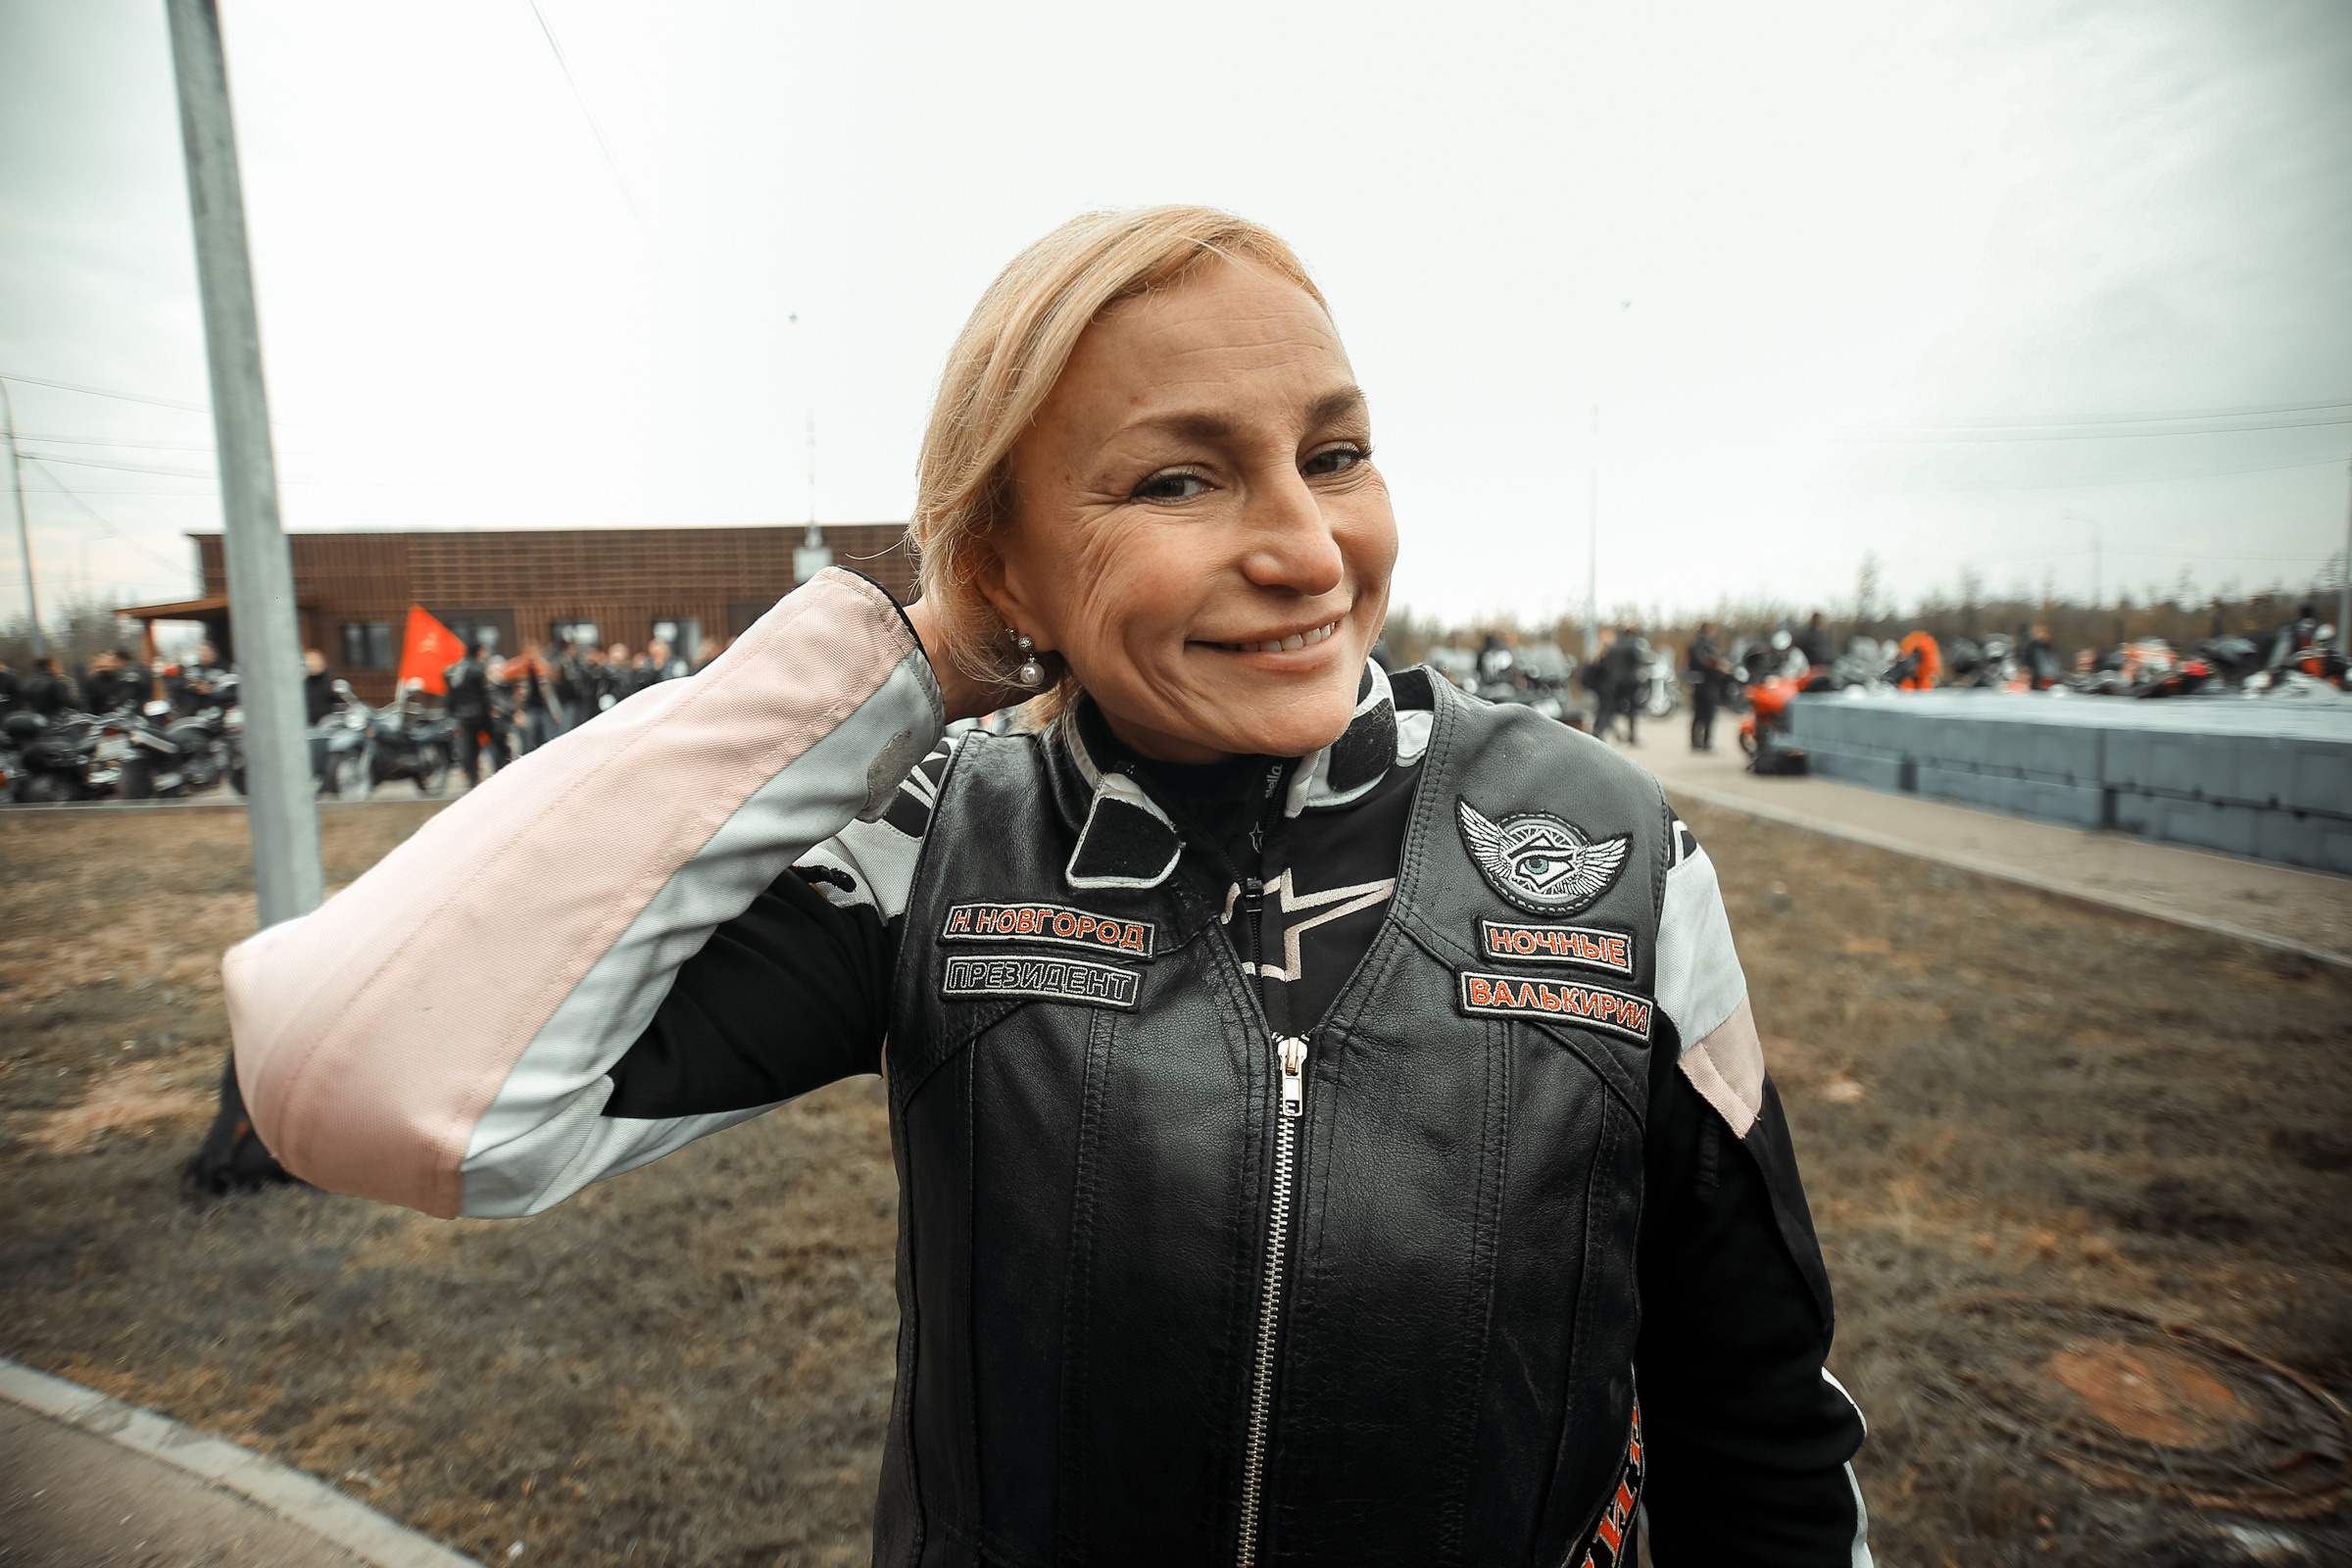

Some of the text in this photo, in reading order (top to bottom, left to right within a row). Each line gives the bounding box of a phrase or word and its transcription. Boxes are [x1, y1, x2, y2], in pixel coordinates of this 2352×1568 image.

[976, 908, 1145, 951] НОВГОРОД
[1490, 927, 1627, 965] НОЧНЫЕ
[949, 961, 1132, 1000] ПРЕЗИДЕНТ
[1470, 977, 1648, 1033] ВАЛЬКИРИИ
